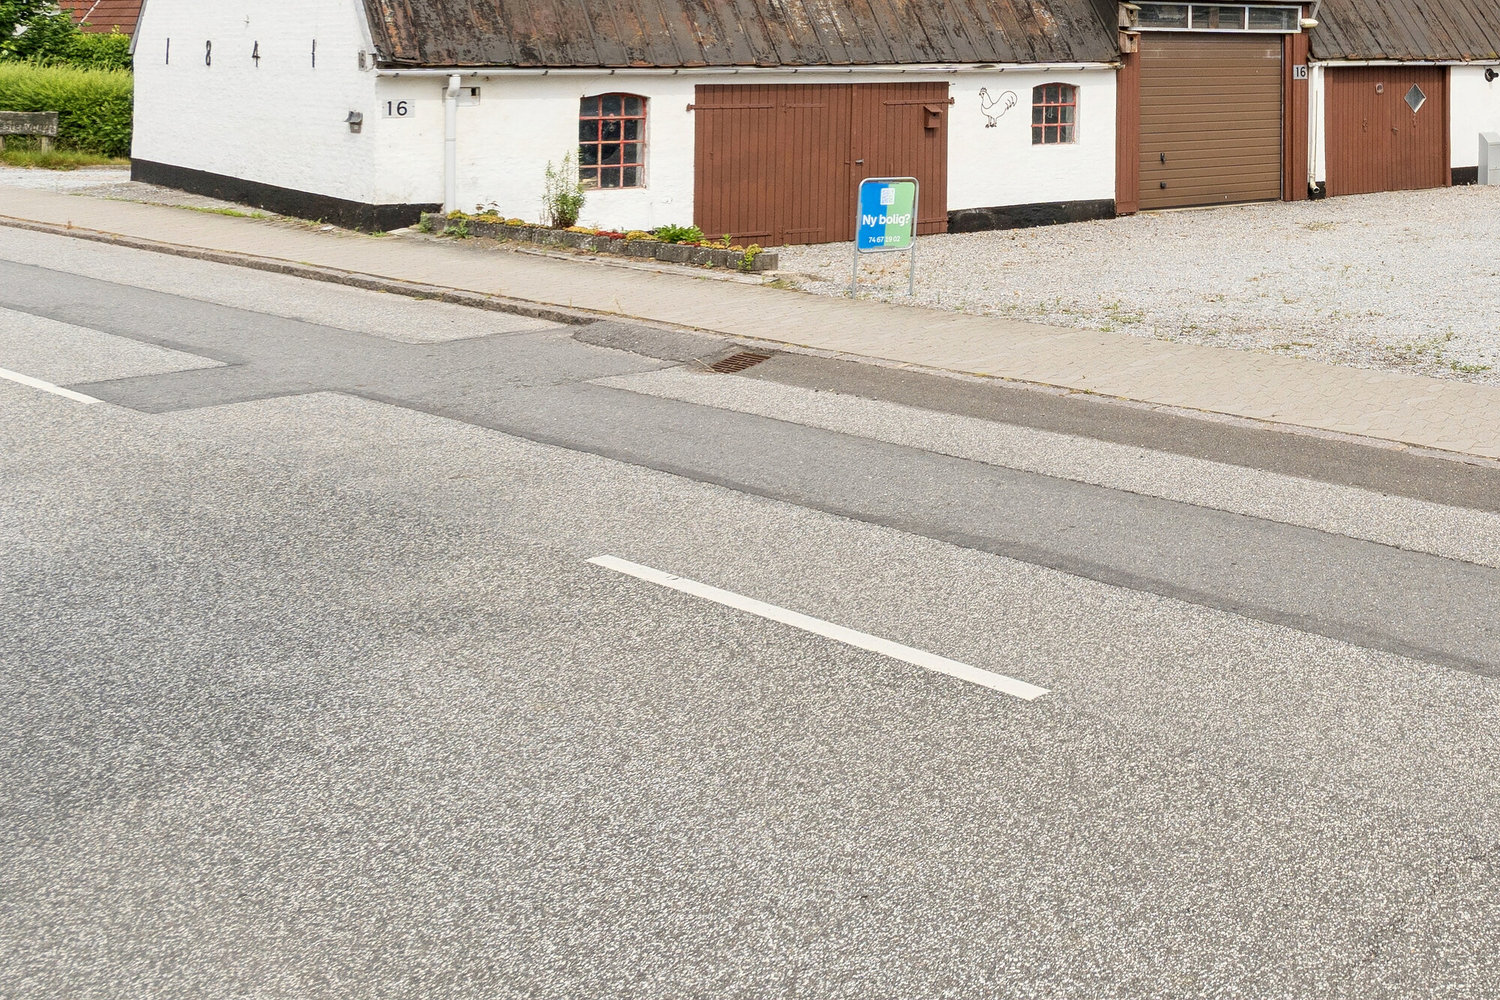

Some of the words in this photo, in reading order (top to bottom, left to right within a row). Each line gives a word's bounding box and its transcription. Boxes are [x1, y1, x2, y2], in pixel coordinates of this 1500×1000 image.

[1295, 66, 1306, 78] 16
[387, 100, 408, 116] 16
[862, 214, 877, 227] Ny
[878, 213, 911, 227] bolig?
